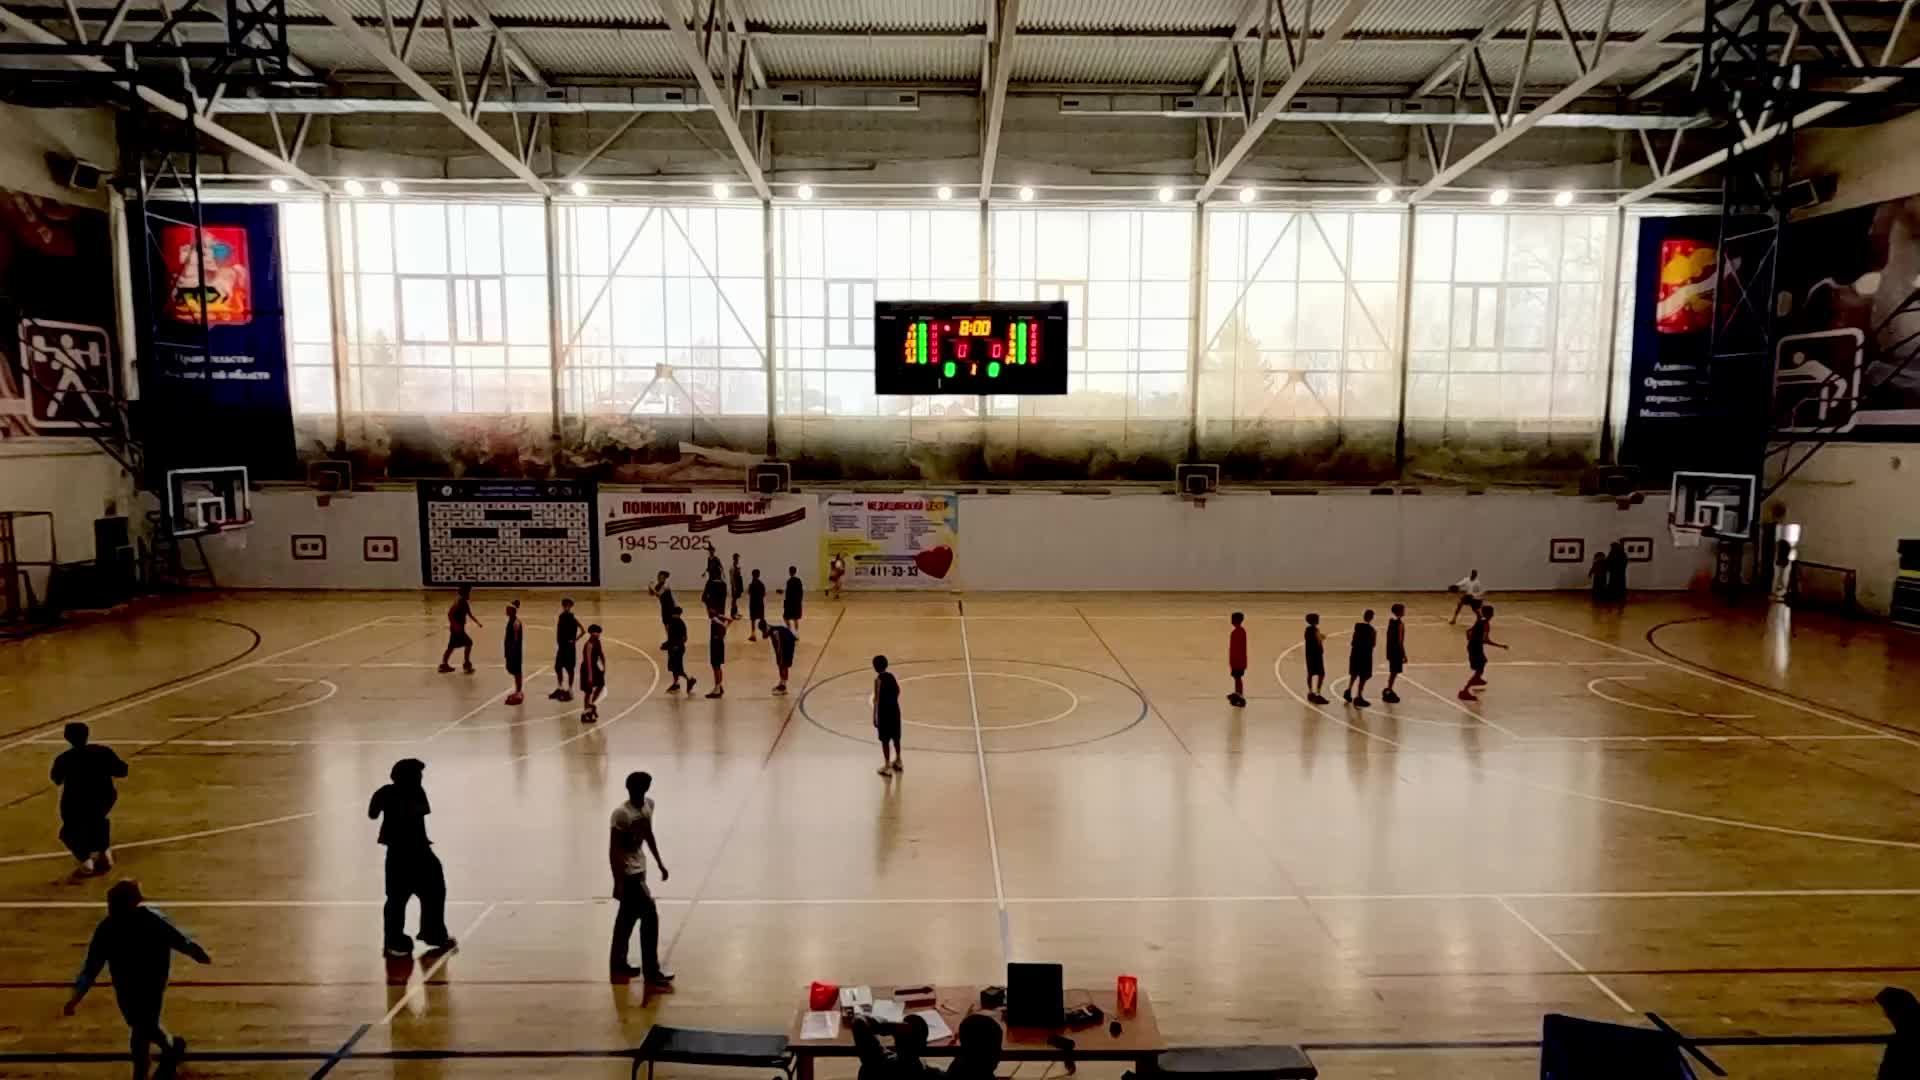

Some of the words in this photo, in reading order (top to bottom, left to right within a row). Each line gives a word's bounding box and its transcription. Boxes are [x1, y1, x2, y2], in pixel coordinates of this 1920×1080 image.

[959, 320, 991, 336] 8:00
[992, 344, 1001, 358] 0
[622, 501, 686, 515] ПОМНИМ!
[693, 501, 766, 516] ГОРДИМСЯ!
[867, 500, 923, 511] МЕДИЦИНСКИЙ
[869, 565, 919, 577] 411-33-33
